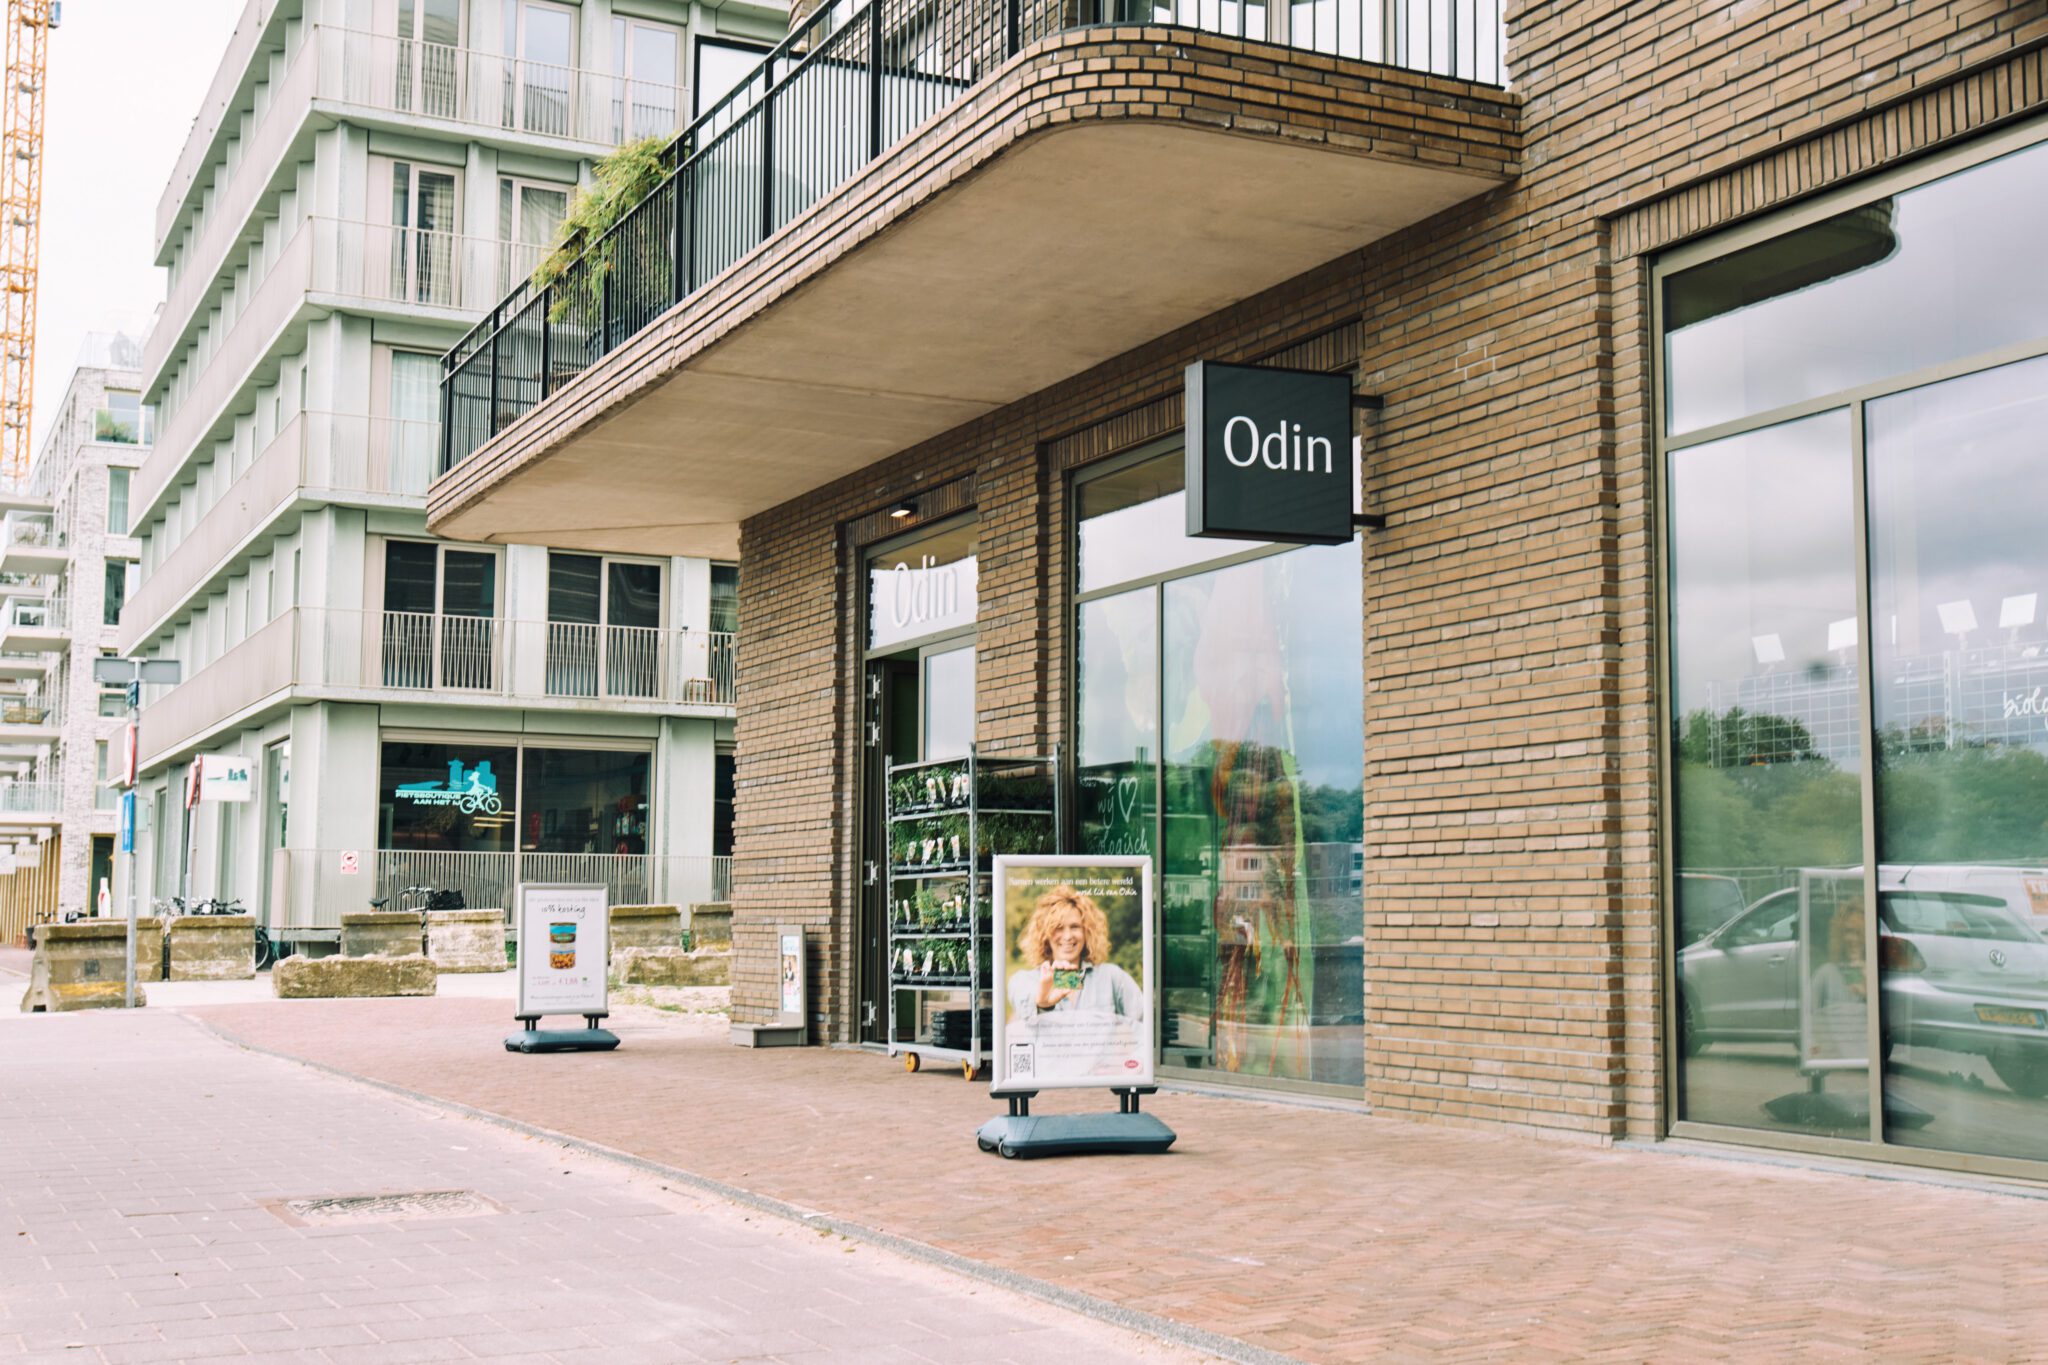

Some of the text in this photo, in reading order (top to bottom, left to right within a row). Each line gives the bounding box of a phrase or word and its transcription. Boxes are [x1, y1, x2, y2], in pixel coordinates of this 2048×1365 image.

[1224, 415, 1332, 473] Odin
[891, 554, 959, 629] Odin
[395, 791, 461, 799] FIETSBOUTIQUE
[1034, 877, 1058, 886] werken
[1060, 878, 1073, 886] aan
[1075, 878, 1088, 886] een
[1089, 876, 1110, 886] betere
[1111, 876, 1133, 886] wereld
